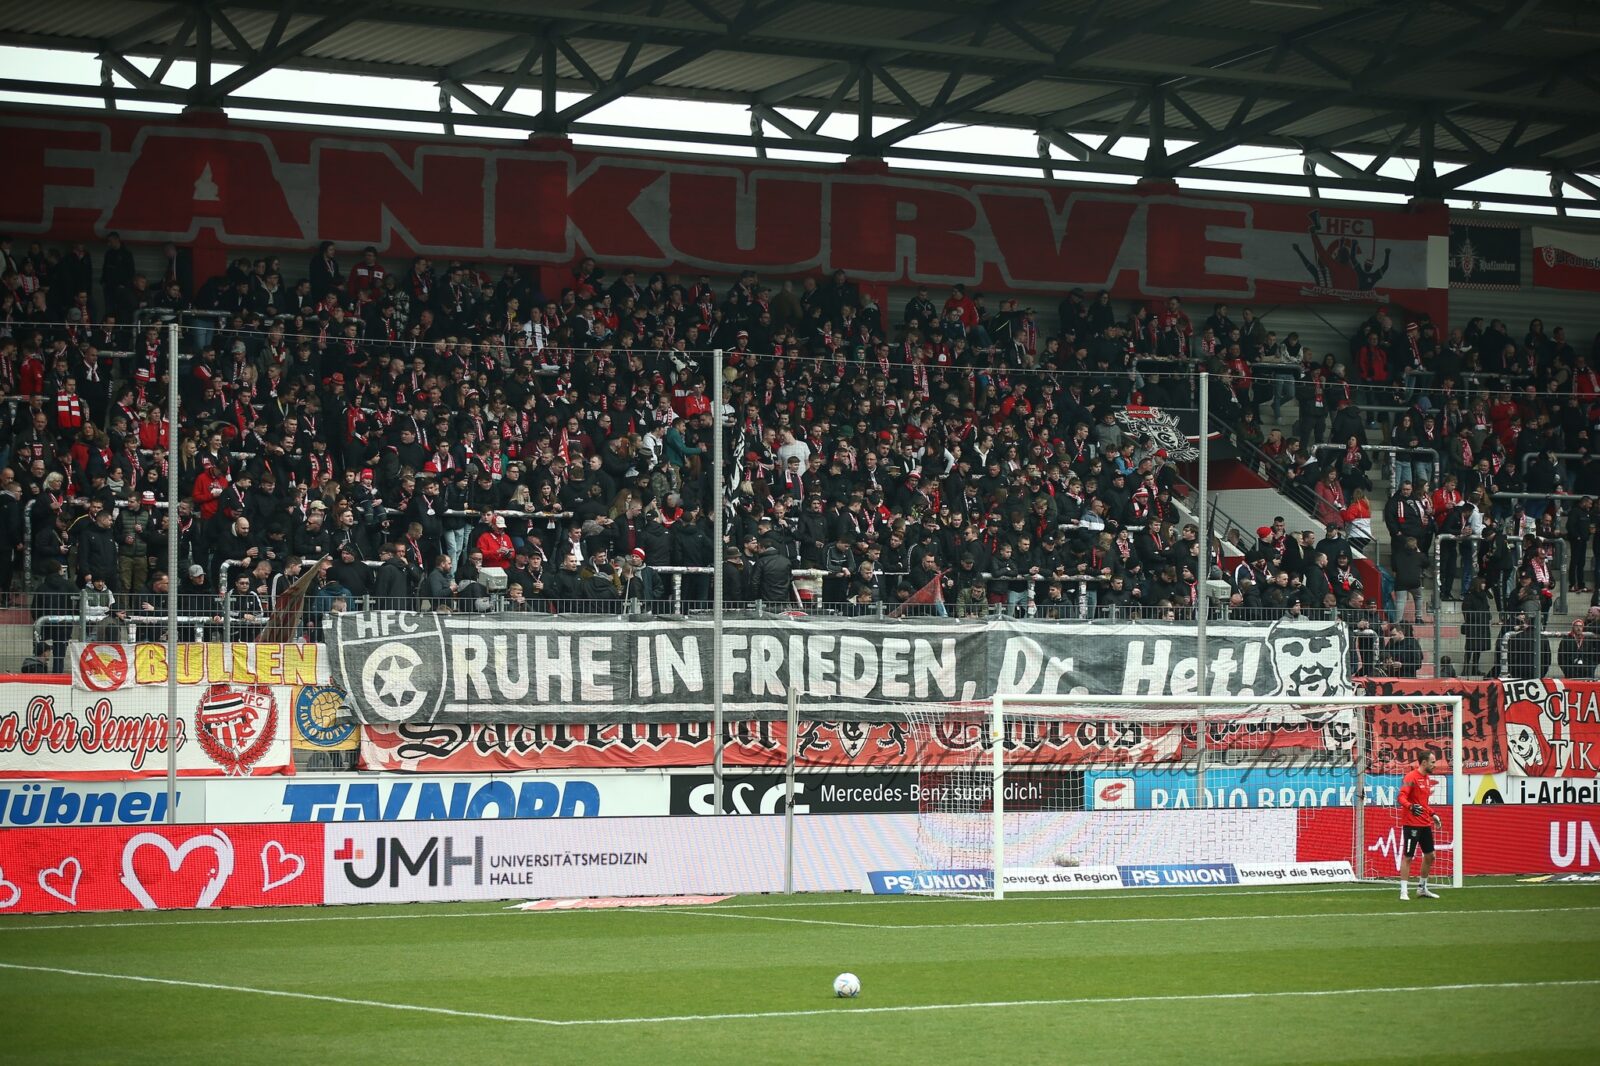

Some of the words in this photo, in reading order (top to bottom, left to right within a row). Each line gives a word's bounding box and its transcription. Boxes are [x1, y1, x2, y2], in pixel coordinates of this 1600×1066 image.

[0, 116, 1255, 300] FANKURVE
[1327, 217, 1363, 234] HFC
[356, 612, 420, 639] HFC
[134, 642, 318, 686] BULLEN
[451, 634, 614, 702] RUHE
[637, 634, 703, 698] IN
[722, 634, 976, 704] FRIEDEN,
[998, 637, 1090, 696] Dr.
[1122, 640, 1262, 697] Het!
[1504, 681, 1540, 705] HFC
[21, 695, 78, 756] Per
[80, 697, 187, 770] Sempre
[820, 783, 949, 802] Mercedes-Benz
[1004, 781, 1043, 802] dich!
[1151, 787, 1248, 810] RADIO
[1260, 785, 1397, 809] BROCKEN
[489, 851, 648, 870] UNIVERSITÄTSMEDIZIN
[490, 870, 534, 886] HALLE
[884, 874, 914, 891] PS
[919, 872, 987, 890] UNION
[1053, 871, 1072, 884] die
[1074, 870, 1119, 884] Region
[1131, 869, 1163, 885] PS
[1168, 867, 1227, 884] UNION
[1240, 867, 1286, 881] bewegt
[1289, 867, 1308, 878] die
[1310, 864, 1352, 879] Region
